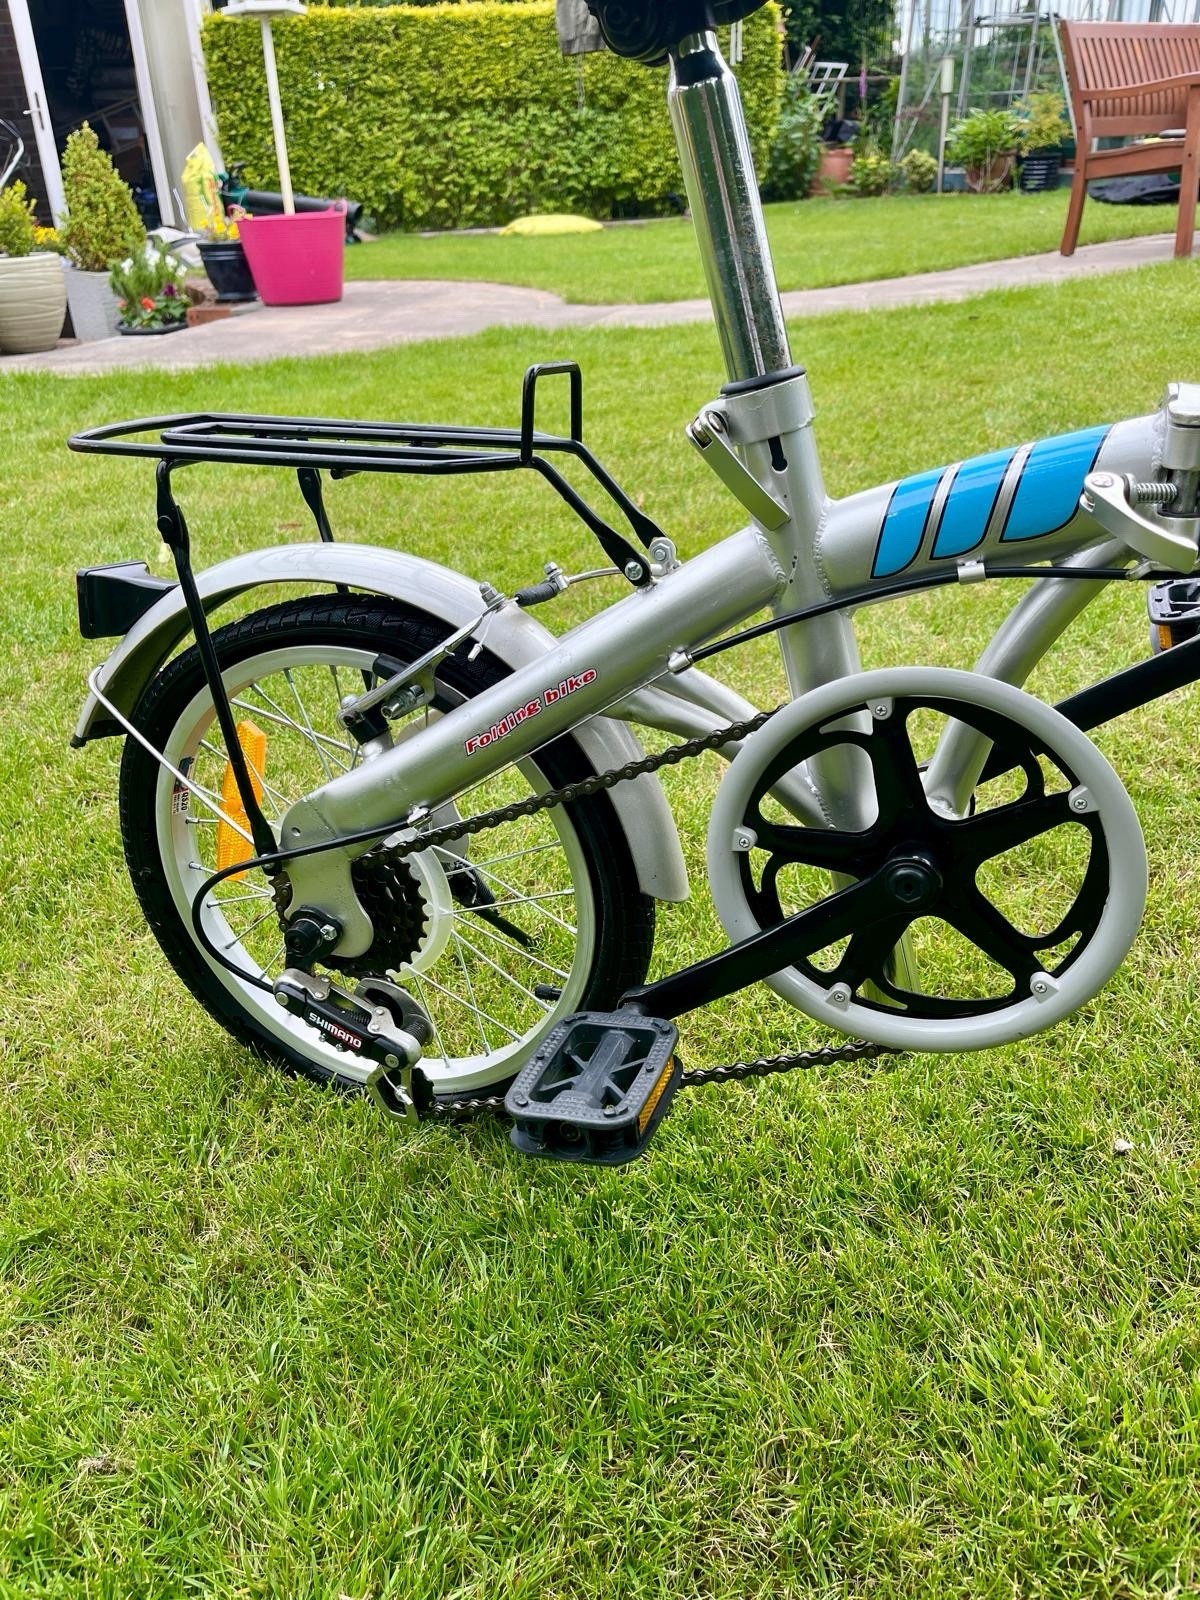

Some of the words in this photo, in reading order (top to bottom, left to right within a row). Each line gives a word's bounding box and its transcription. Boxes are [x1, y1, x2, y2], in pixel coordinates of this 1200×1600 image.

[465, 698, 542, 756] Folding
[543, 668, 597, 706] bike
[308, 1012, 362, 1048] SHIMANO
